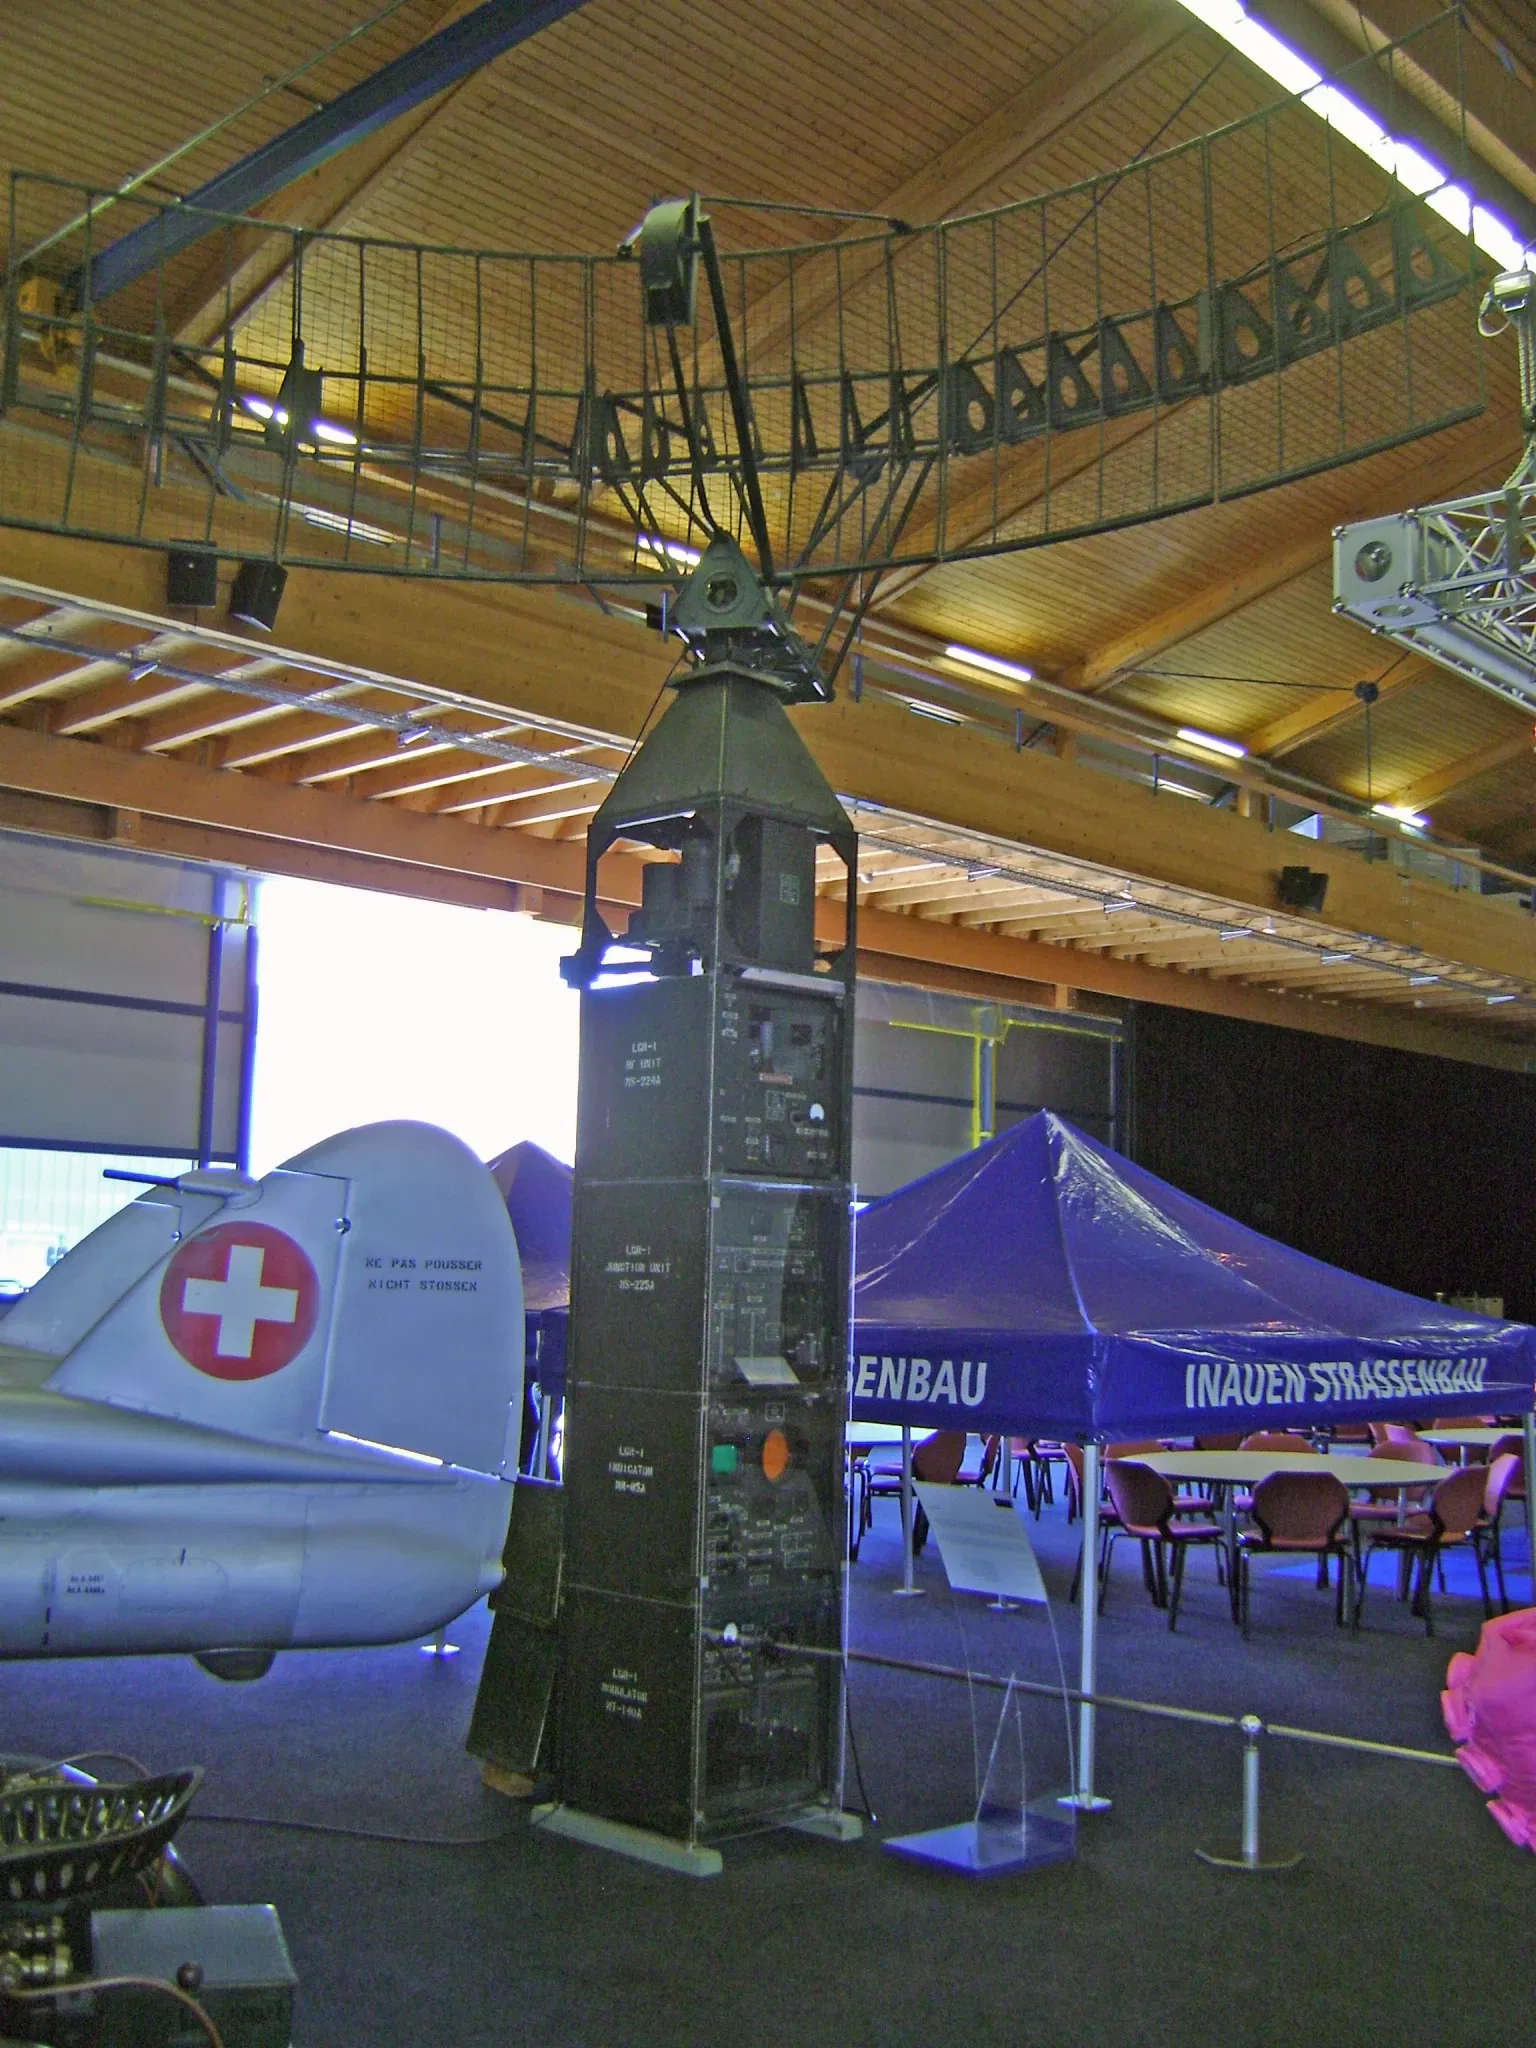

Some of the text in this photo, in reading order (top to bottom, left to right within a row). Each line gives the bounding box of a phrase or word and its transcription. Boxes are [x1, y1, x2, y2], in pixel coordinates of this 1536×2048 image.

[640, 1057, 662, 1069] UNIT
[365, 1257, 482, 1271] NE PAS POUSSER
[605, 1261, 671, 1273] JUNCTION UNIT
[368, 1279, 477, 1292] NICHT STOSSEN
[1185, 1357, 1487, 1409] INAUEN STRASSENBAU
[608, 1461, 653, 1477] INDICATOR
[601, 1682, 648, 1703] MODULATOR
